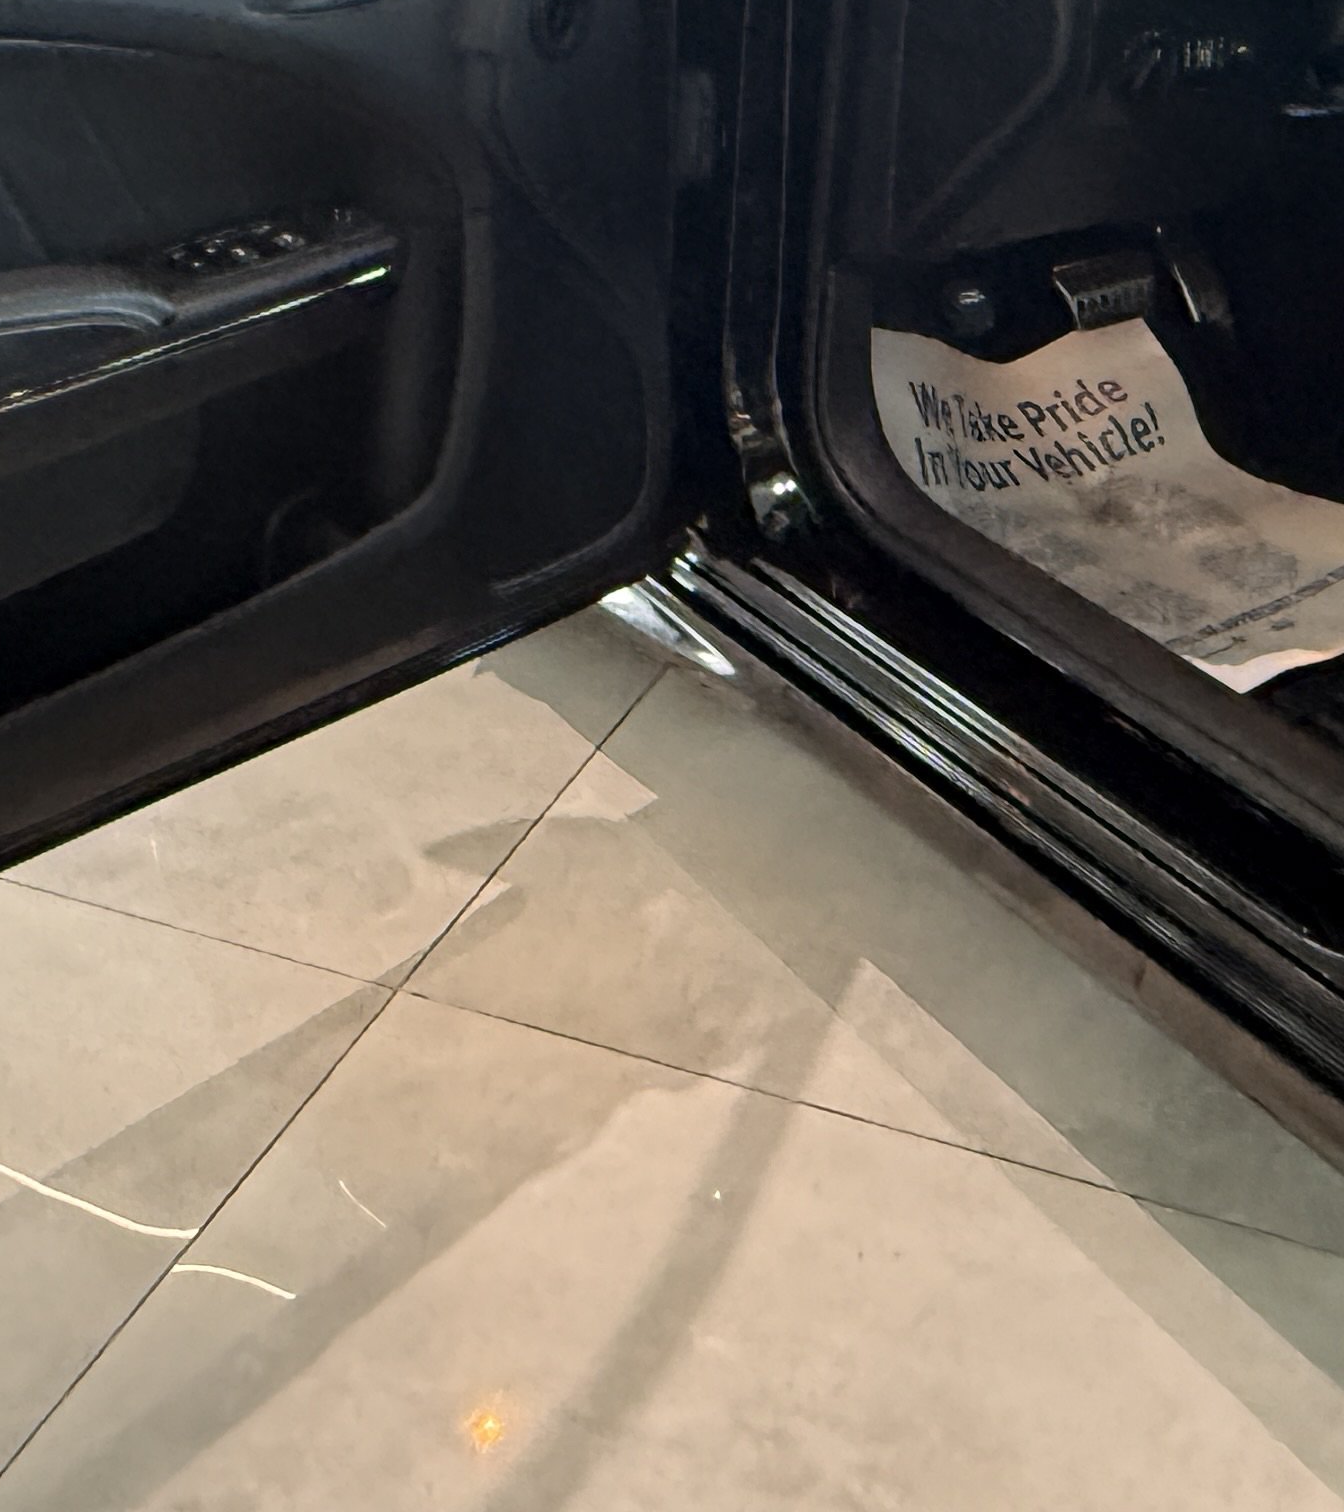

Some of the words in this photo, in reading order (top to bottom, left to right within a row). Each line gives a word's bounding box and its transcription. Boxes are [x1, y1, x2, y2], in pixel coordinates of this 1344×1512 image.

[908, 380, 954, 437] We
[954, 393, 1025, 443] Take
[1017, 379, 1129, 438] Pride
[914, 437, 949, 487] In
[947, 441, 1021, 492] Your
[1012, 401, 1166, 483] Vehicle!
